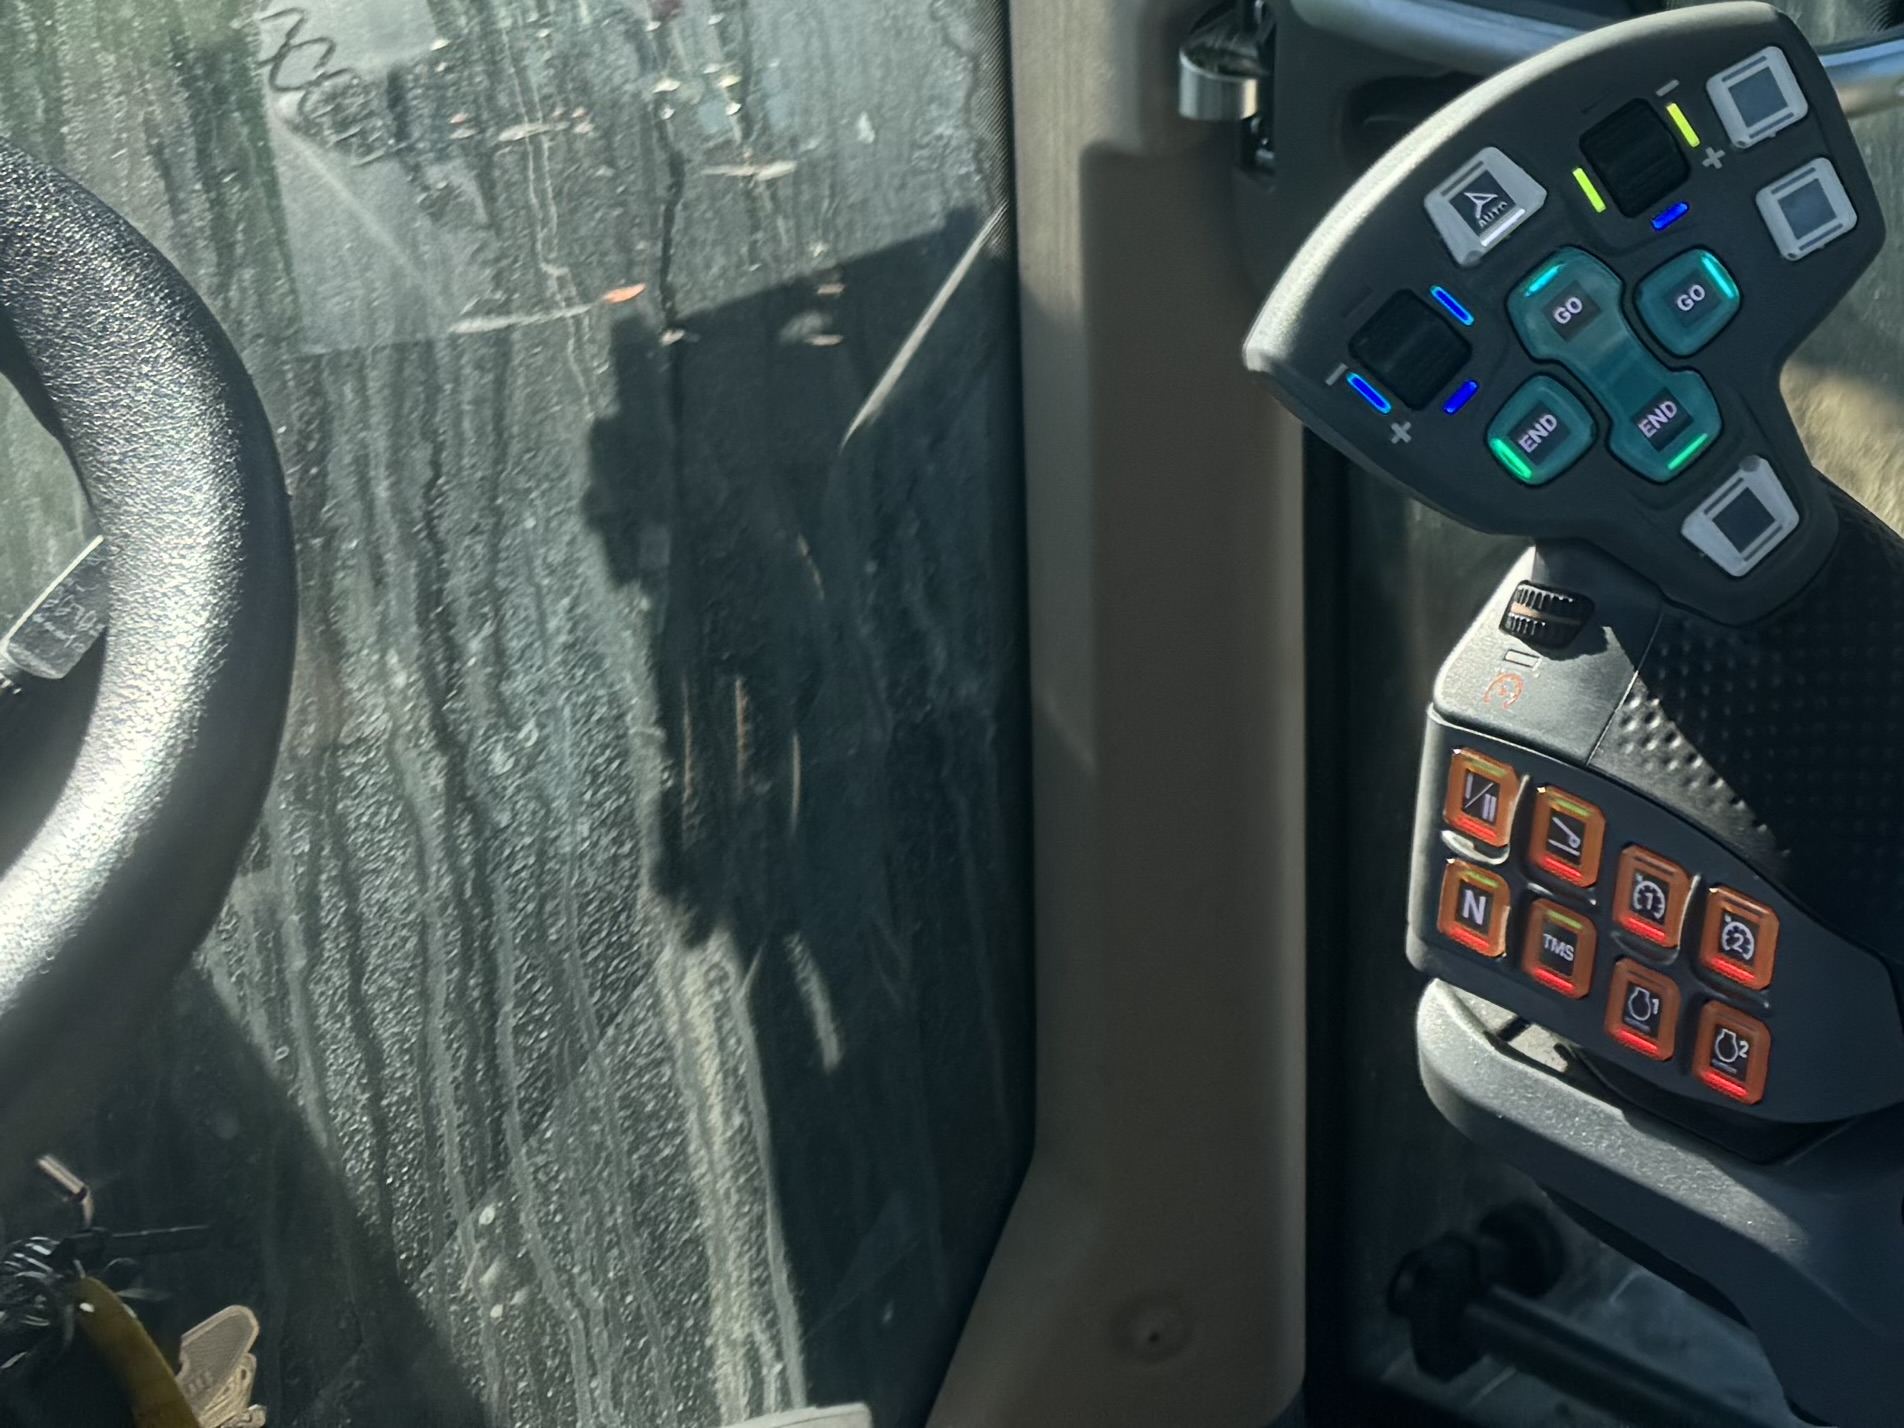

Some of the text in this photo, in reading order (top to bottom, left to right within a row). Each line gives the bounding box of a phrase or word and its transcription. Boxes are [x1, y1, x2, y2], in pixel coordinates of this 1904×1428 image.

[1553, 296, 1584, 324] GO
[1675, 284, 1706, 312] GO
[1517, 413, 1558, 453] END
[1637, 400, 1678, 439] END
[1461, 889, 1486, 925] N
[1542, 932, 1575, 963] TMS
[1732, 933, 1745, 952] 2
[1738, 1040, 1749, 1058] 2
